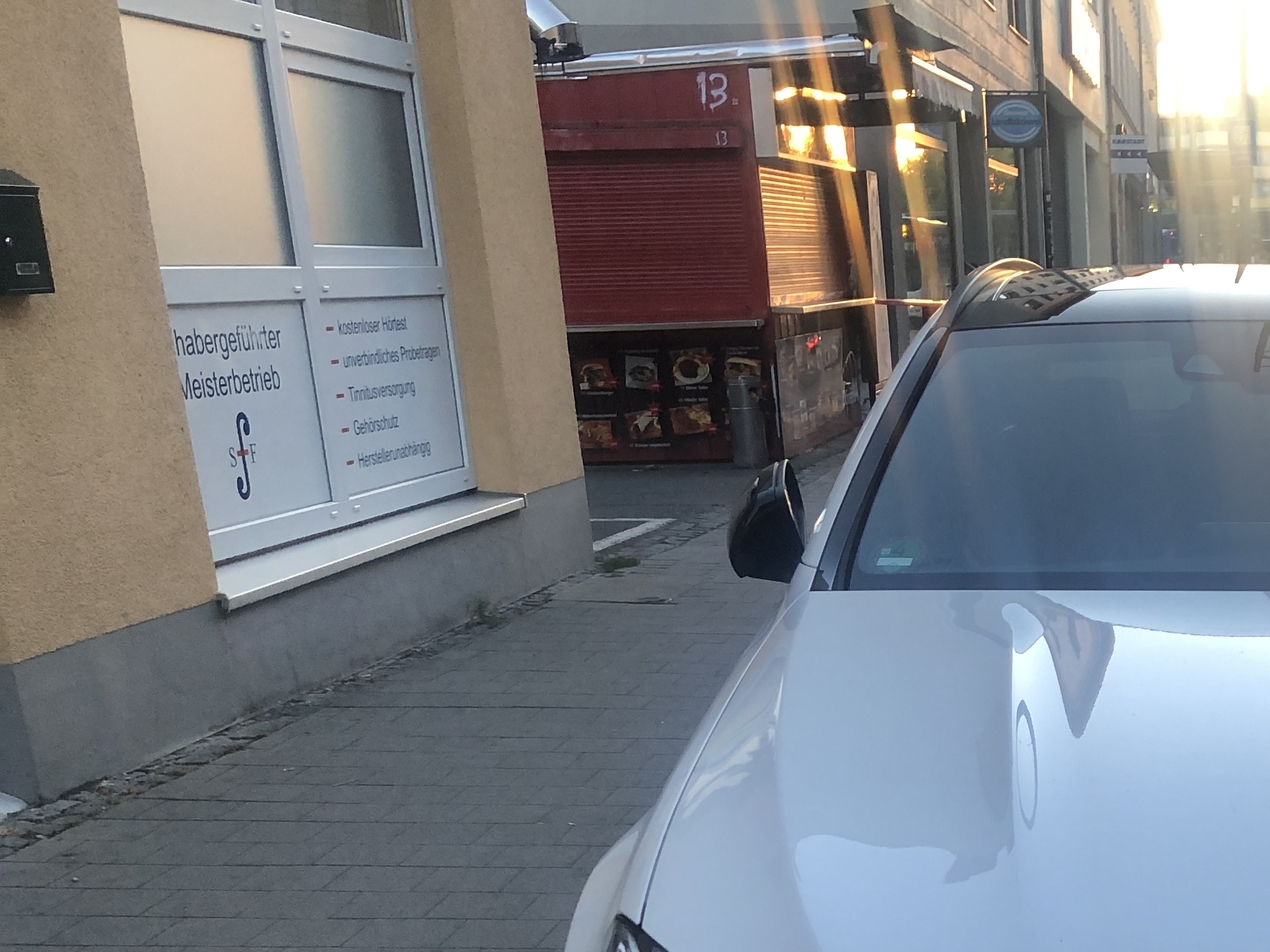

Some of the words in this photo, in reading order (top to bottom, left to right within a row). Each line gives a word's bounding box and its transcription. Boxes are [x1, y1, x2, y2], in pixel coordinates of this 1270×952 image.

[696, 72, 728, 110] 13
[715, 130, 728, 146] 13
[337, 318, 381, 335] kostenloser
[381, 316, 408, 331] Hörtest
[343, 347, 400, 368] unverbindliches
[400, 345, 440, 362] Probetragen
[348, 381, 416, 402] Tinnitusversorgung
[353, 414, 399, 435] Gehörschutz
[357, 439, 431, 468] Herstellerunabhängig
